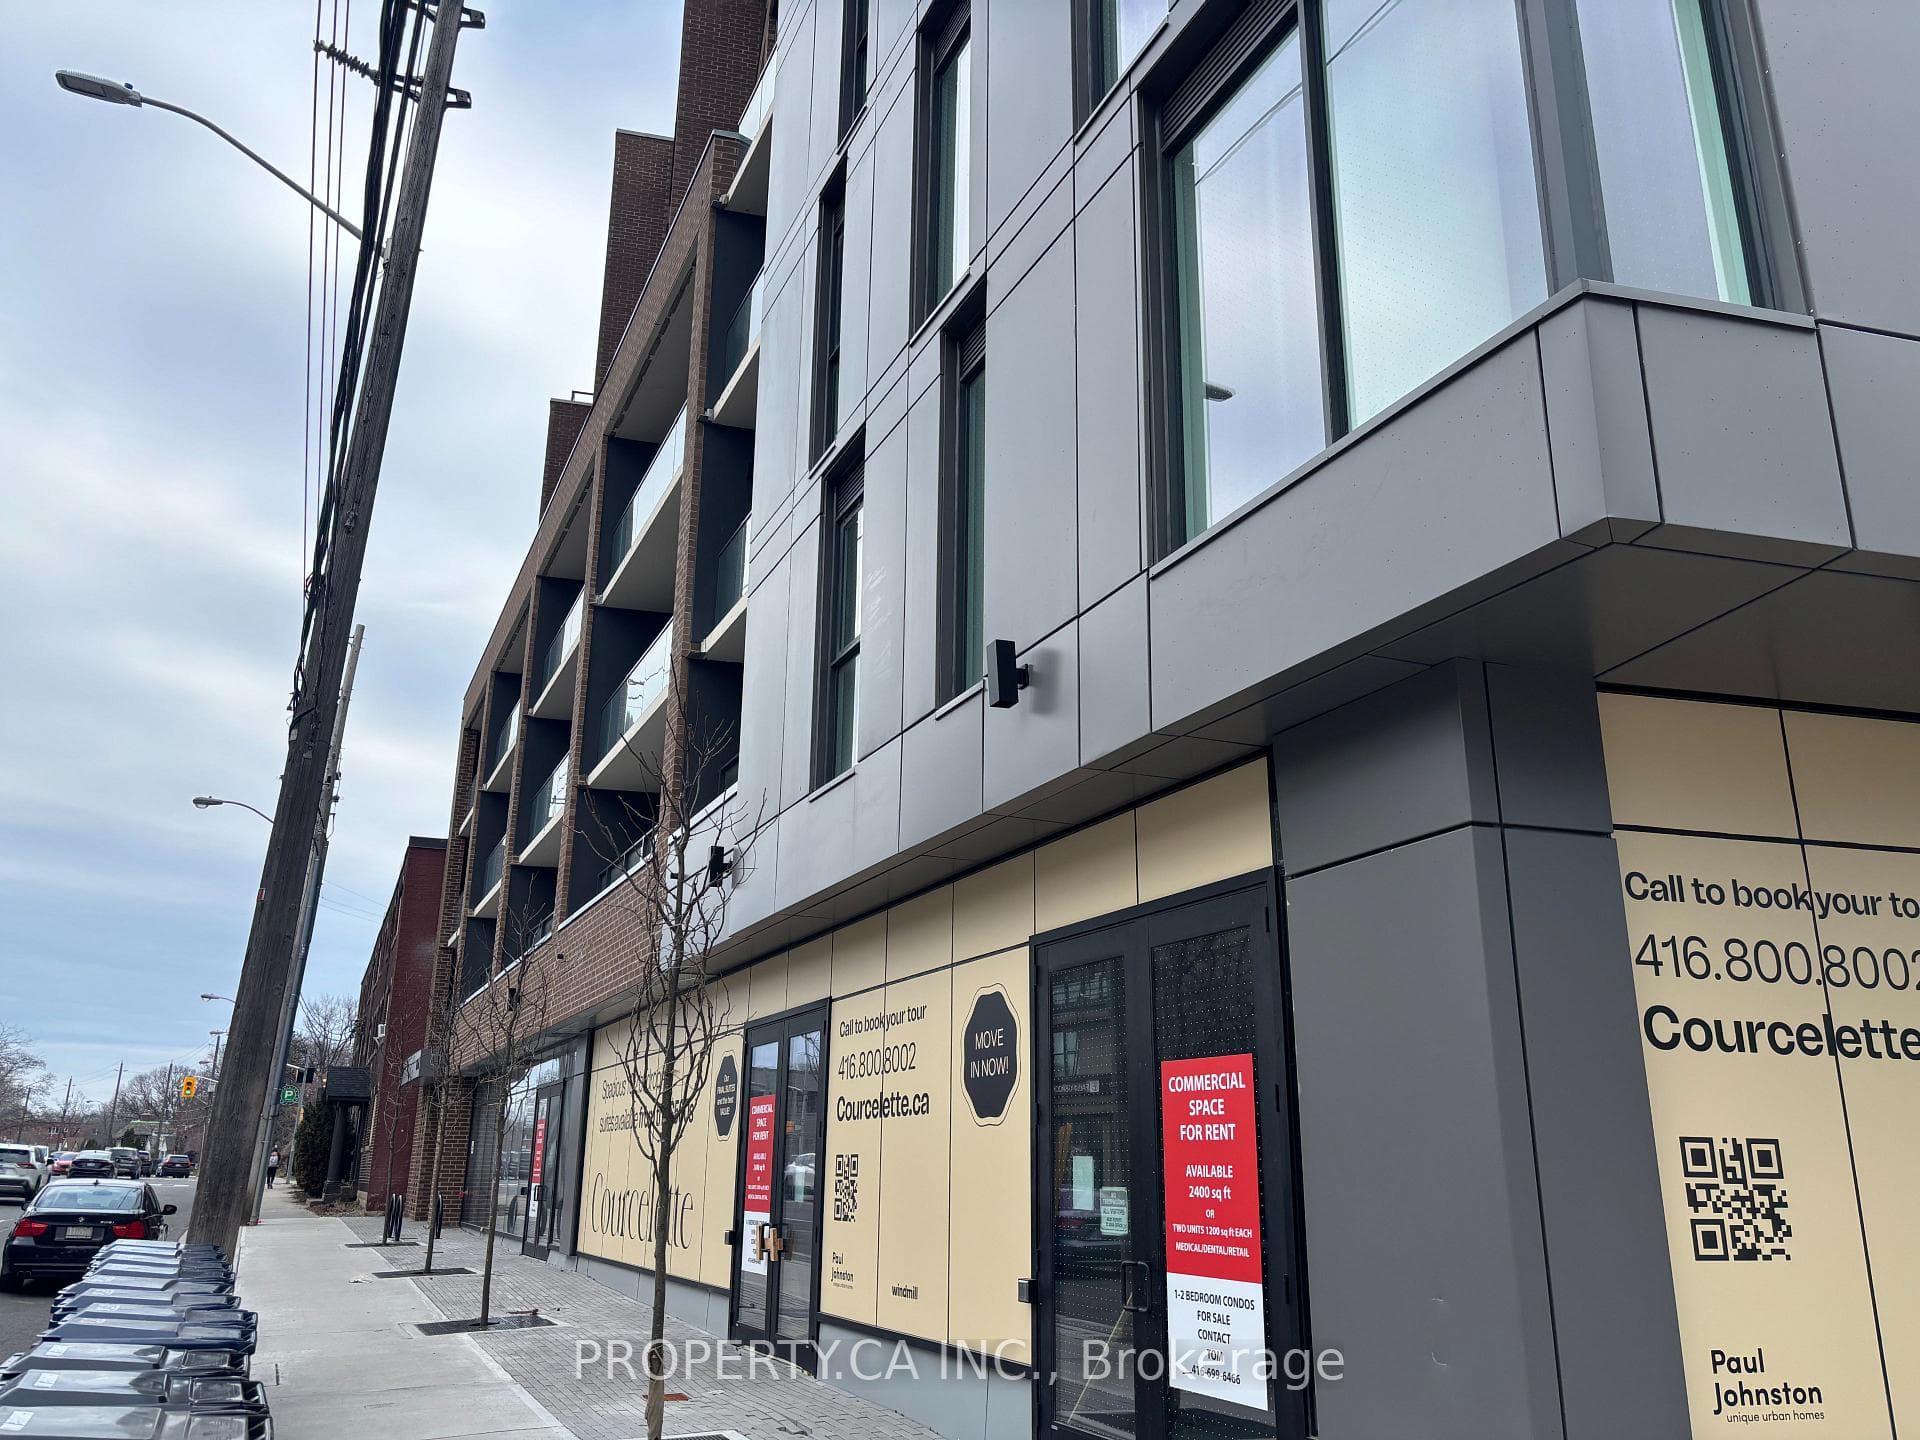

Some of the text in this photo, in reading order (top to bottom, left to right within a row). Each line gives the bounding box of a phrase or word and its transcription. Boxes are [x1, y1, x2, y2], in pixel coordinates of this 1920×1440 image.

[1625, 871, 1685, 903] Call
[1691, 877, 1725, 906] to
[1732, 879, 1813, 911] book
[1815, 891, 1882, 920] your
[839, 1004, 927, 1038] Call to book your tour
[975, 1028, 1004, 1050] MOVE
[1644, 1005, 1920, 1061] Courcelette
[838, 1041, 917, 1081] 416.800.8002
[970, 1055, 1009, 1079] IN NOW!
[1168, 1072, 1246, 1093] COMMERCIAL
[837, 1091, 930, 1122] Courcelette.ca
[1189, 1099, 1225, 1116] SPACE
[1180, 1123, 1236, 1141] FOR RENT
[1186, 1164, 1233, 1178] AVAILABLE
[1189, 1185, 1231, 1202] 2400 sq ft
[1205, 1209, 1215, 1219] OR
[1173, 1223, 1252, 1239] TWO UNITS 1200 sq ft EACH
[832, 1251, 844, 1265] Paul
[1175, 1241, 1250, 1258] MEDICAL/DENTAL/RETAIL
[891, 1283, 919, 1300] windmill
[1174, 1289, 1255, 1311] 1-2 BEDROOM CONDOS
[1197, 1310, 1231, 1326] FOR SALE
[1198, 1329, 1231, 1344] CONTACT
[1711, 1348, 1764, 1374] Paul
[1713, 1381, 1823, 1415] Johnston
[1726, 1409, 1825, 1425] unique urban homes
